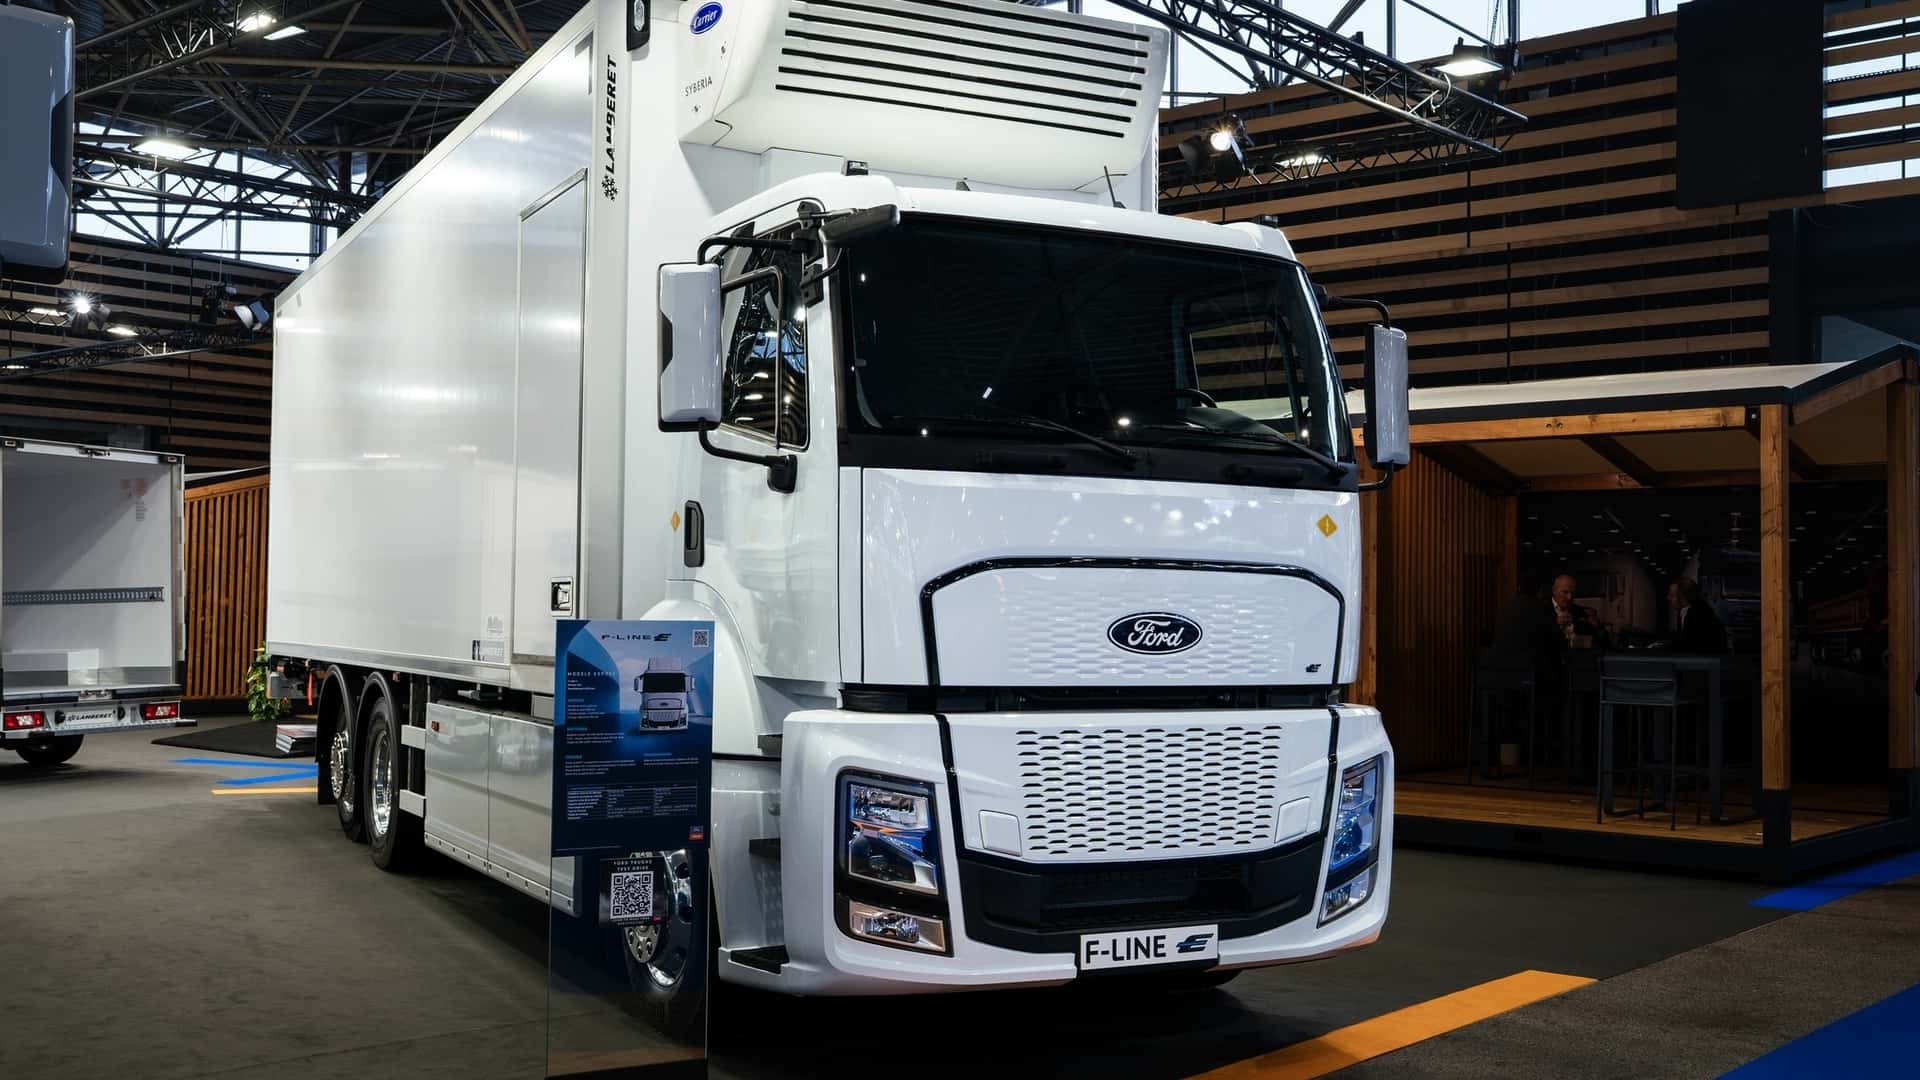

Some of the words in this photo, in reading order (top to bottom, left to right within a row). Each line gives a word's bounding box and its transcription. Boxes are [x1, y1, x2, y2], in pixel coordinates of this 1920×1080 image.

[694, 9, 719, 29] Carrier
[685, 75, 713, 97] SYBERIA
[605, 54, 617, 175] LAMBERET
[1128, 619, 1184, 647] Ford
[1086, 935, 1166, 964] F-LINE
